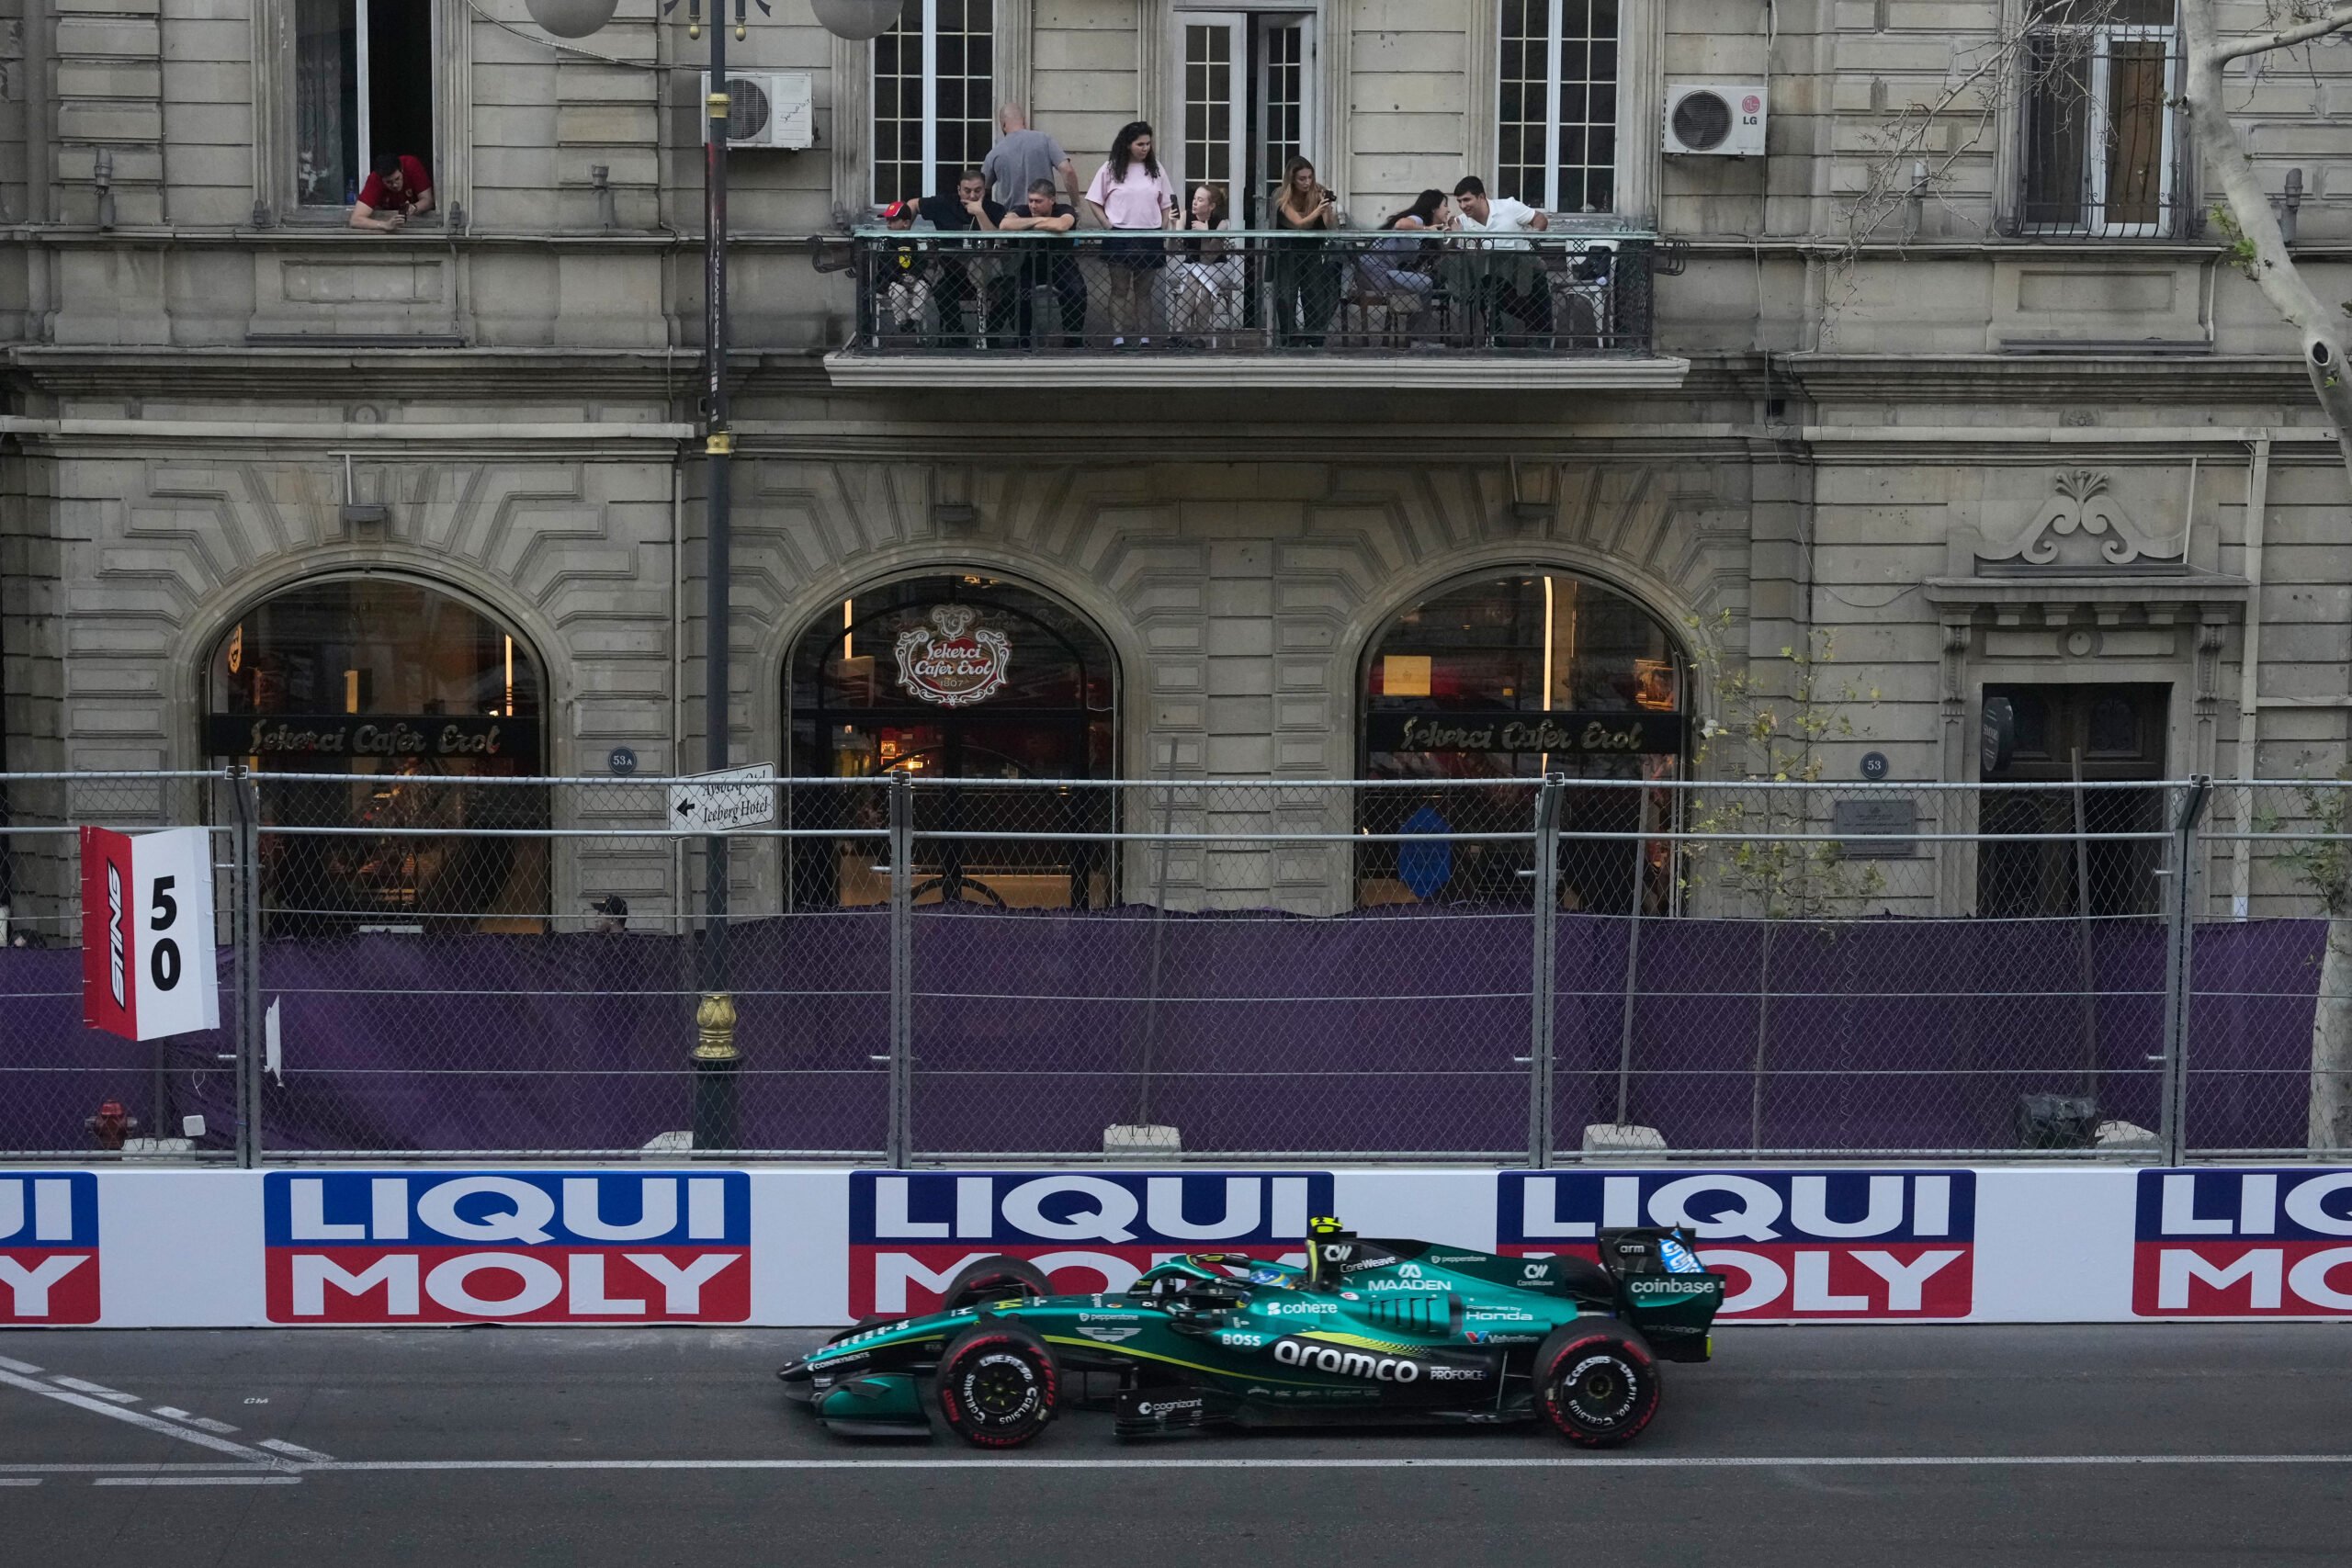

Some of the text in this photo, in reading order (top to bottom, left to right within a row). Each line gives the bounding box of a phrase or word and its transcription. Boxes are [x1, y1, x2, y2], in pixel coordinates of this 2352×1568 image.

[1743, 116, 1758, 125] LG
[914, 660, 992, 678] Cafer Erol
[352, 722, 427, 756] Cafer
[437, 724, 501, 755] Erol
[1501, 718, 1572, 751] Cafer
[1579, 721, 1644, 750] Erol
[1867, 760, 1883, 771] 53
[703, 795, 768, 824] Iceberg Hotel
[107, 856, 126, 1012] STING
[290, 1176, 726, 1246] LIQUI
[875, 1175, 1309, 1245] LIQUI
[1522, 1174, 1951, 1242] LIQUI
[1620, 1245, 1645, 1254] arm
[1340, 1255, 1396, 1274] CoreWeave
[291, 1251, 743, 1316] MOLY
[1367, 1280, 1452, 1292] MAADEN
[1631, 1278, 1715, 1293] coinbase
[1283, 1302, 1339, 1314] cohere
[1465, 1311, 1533, 1321] Honda
[1091, 1314, 1139, 1322] pepperstone
[1222, 1334, 1261, 1347] BOSS
[1273, 1340, 1419, 1383] aramco
[1430, 1370, 1483, 1381] PROFORCE
[1152, 1398, 1203, 1413] cognizant
